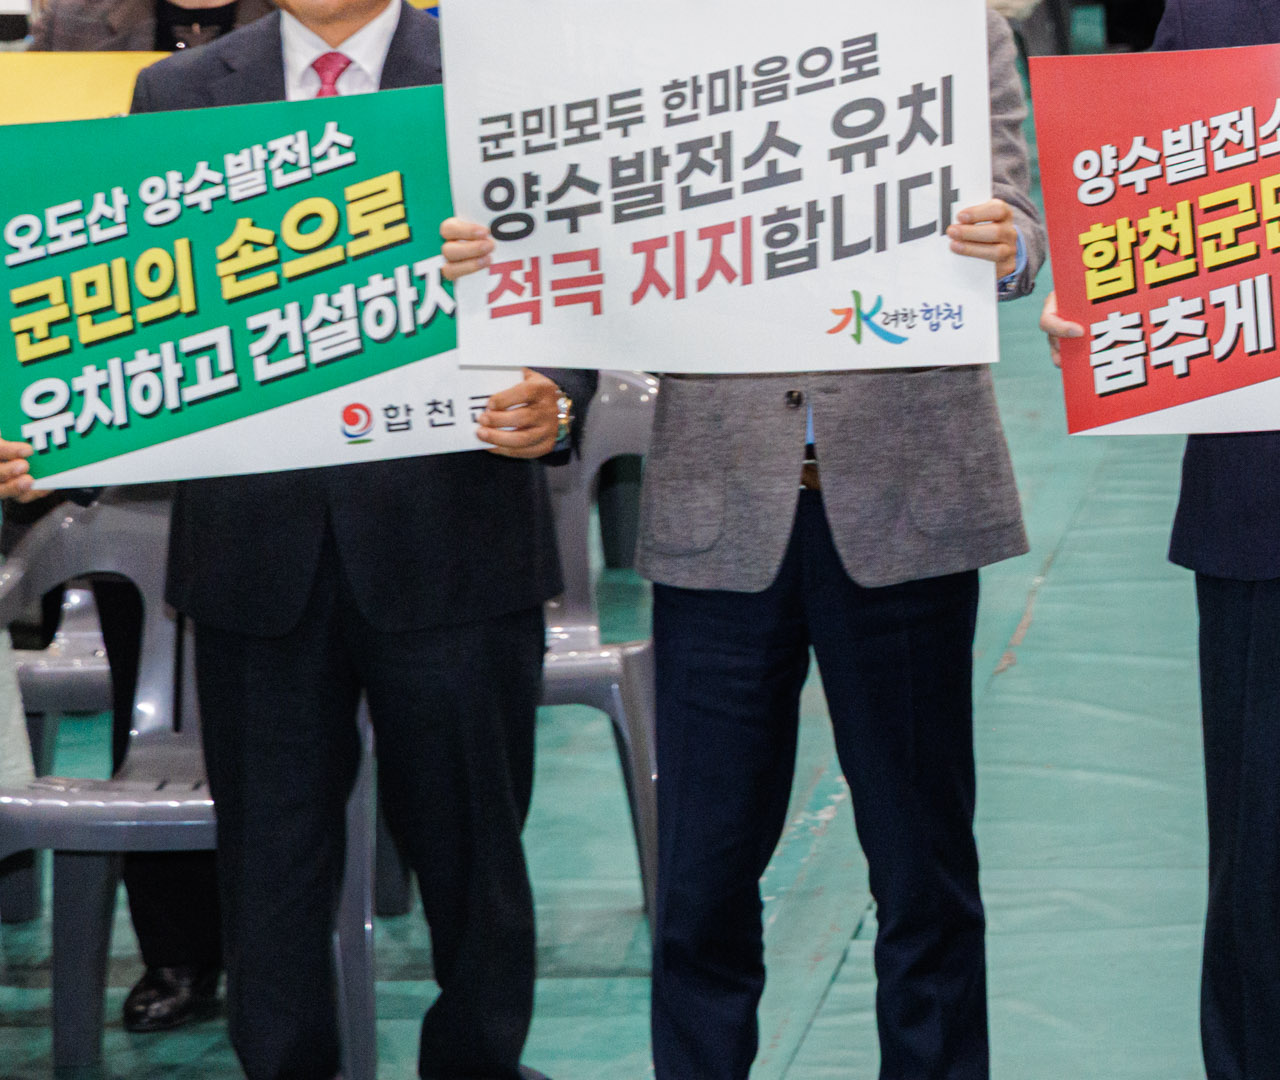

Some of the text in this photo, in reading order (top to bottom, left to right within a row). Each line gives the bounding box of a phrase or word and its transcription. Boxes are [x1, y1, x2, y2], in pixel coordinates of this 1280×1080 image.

[478, 32, 881, 163] 군민모두 한마음으로
[482, 74, 956, 242] 양수발전소 유치
[3, 121, 357, 267] 오도산 양수발전소
[486, 165, 961, 327] 적극 지지합니다
[10, 170, 411, 364] 군민의 손으로
[919, 302, 964, 332] 합천
[1089, 272, 1277, 396] 춤추게
[20, 324, 239, 453] 유치하고
